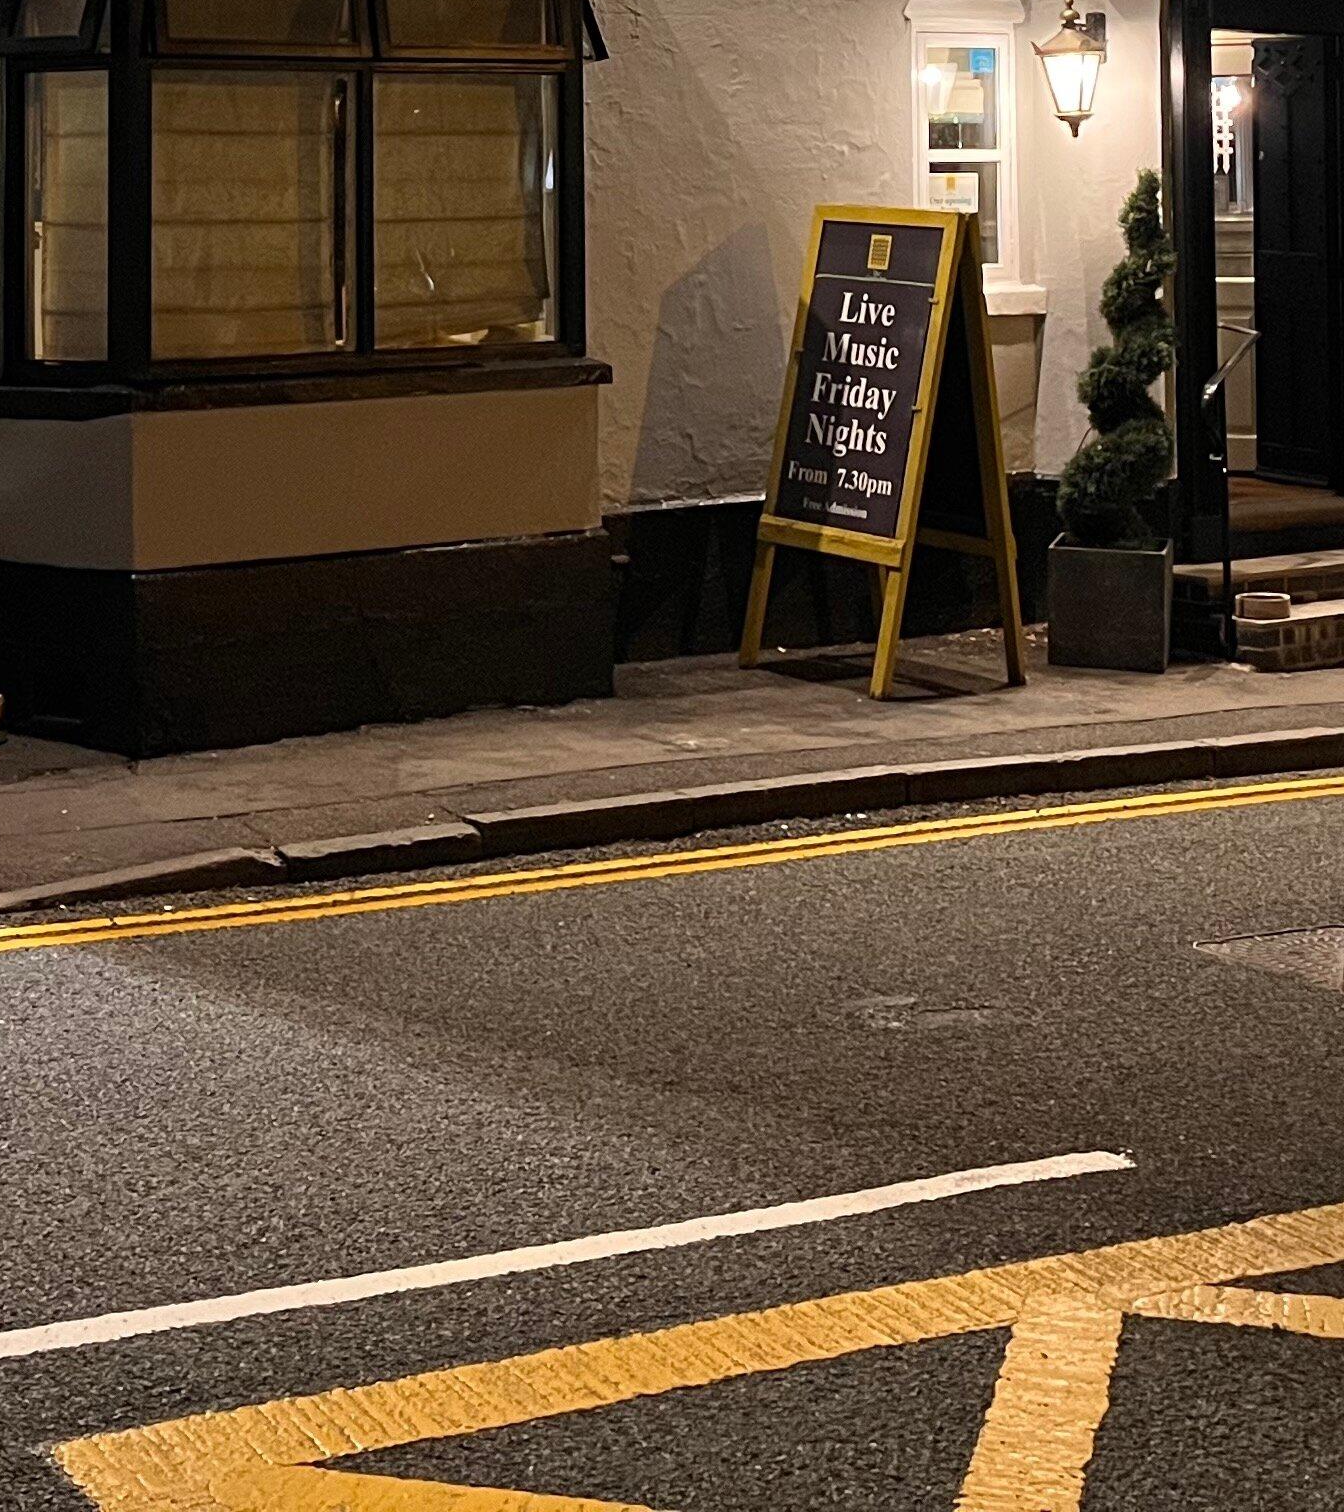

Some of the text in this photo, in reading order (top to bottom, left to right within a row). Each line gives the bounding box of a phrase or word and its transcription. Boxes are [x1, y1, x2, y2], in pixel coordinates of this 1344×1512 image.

[839, 291, 896, 327] Live
[821, 331, 900, 370] Music
[810, 371, 897, 420] Friday
[804, 412, 887, 458] Nights
[788, 460, 893, 498] From 7.30pm
